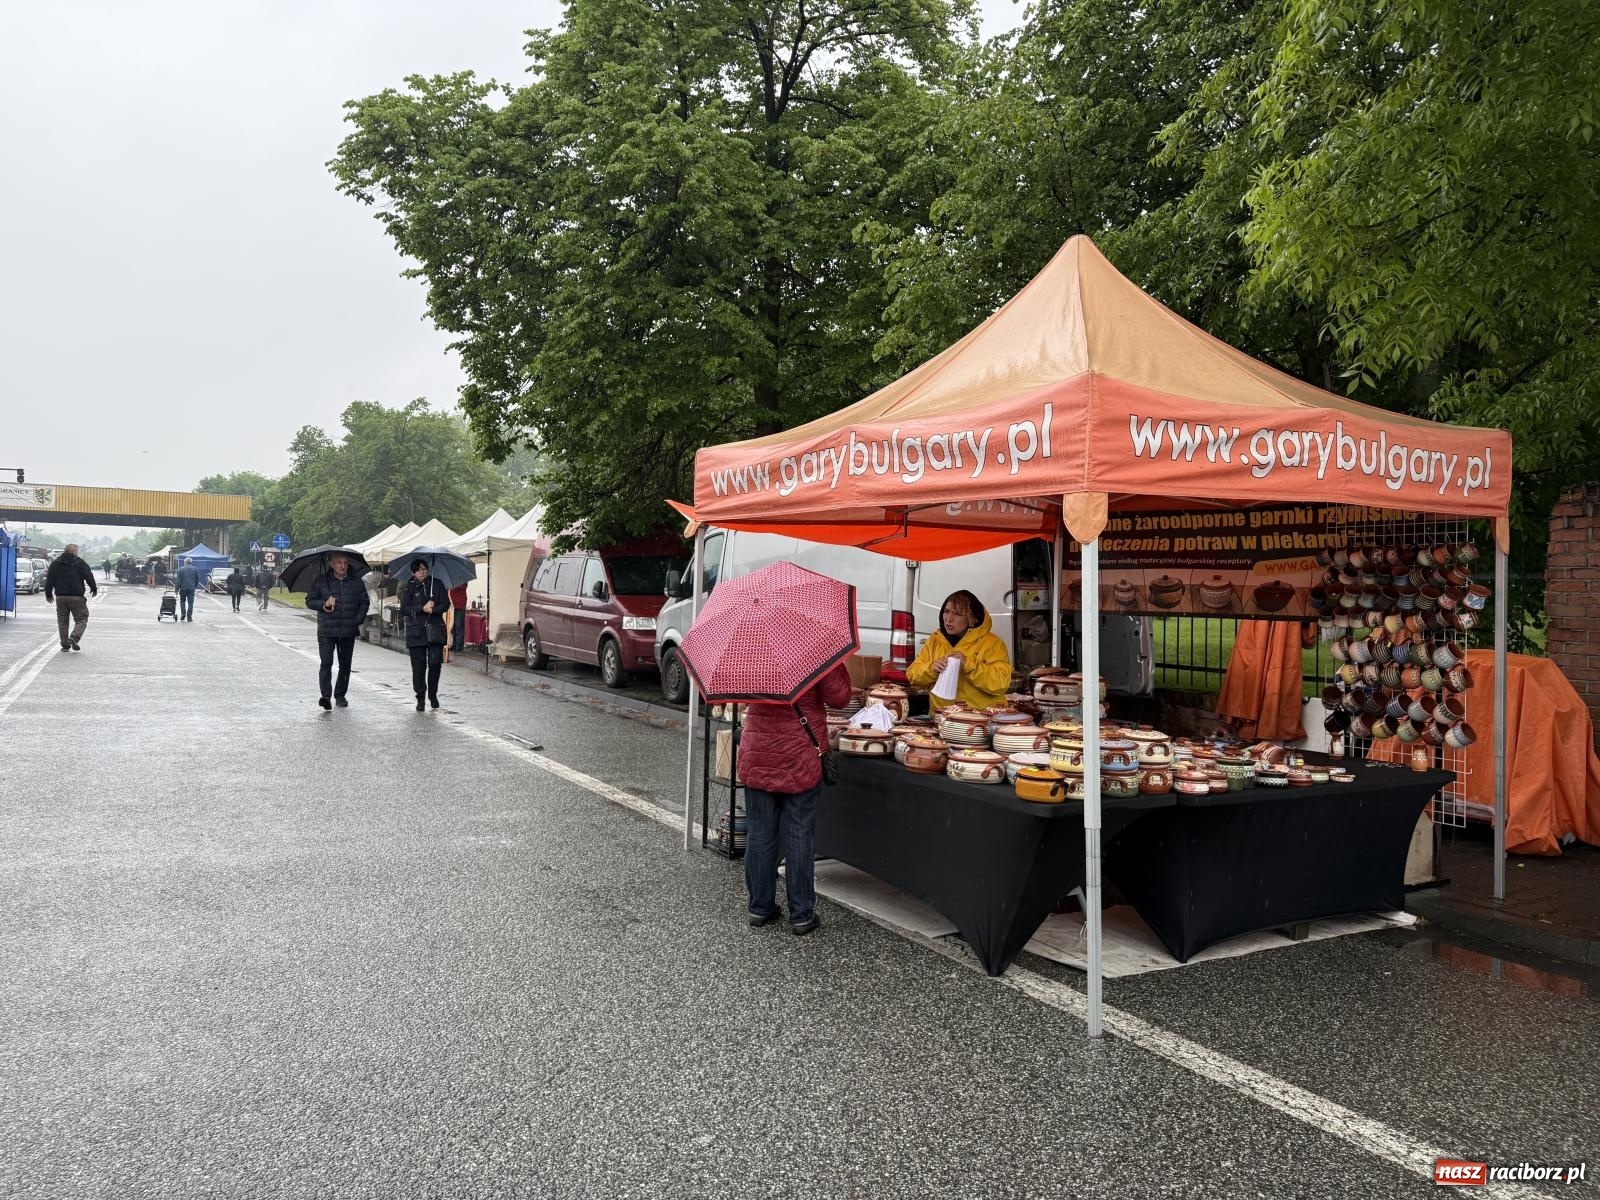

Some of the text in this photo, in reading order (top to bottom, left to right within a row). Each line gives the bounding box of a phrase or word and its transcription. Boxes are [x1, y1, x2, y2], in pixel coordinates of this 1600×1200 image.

[710, 402, 1054, 497] www.garybulgary.pl
[1128, 413, 1492, 497] www.garybulgary.pl
[1135, 511, 1246, 531] żaroodporne
[1250, 506, 1313, 528] garnki
[1098, 535, 1169, 552] ieczenia
[1174, 535, 1238, 553] potraw
[1241, 535, 1257, 550] w
[1265, 559, 1321, 574] WWW.GA
